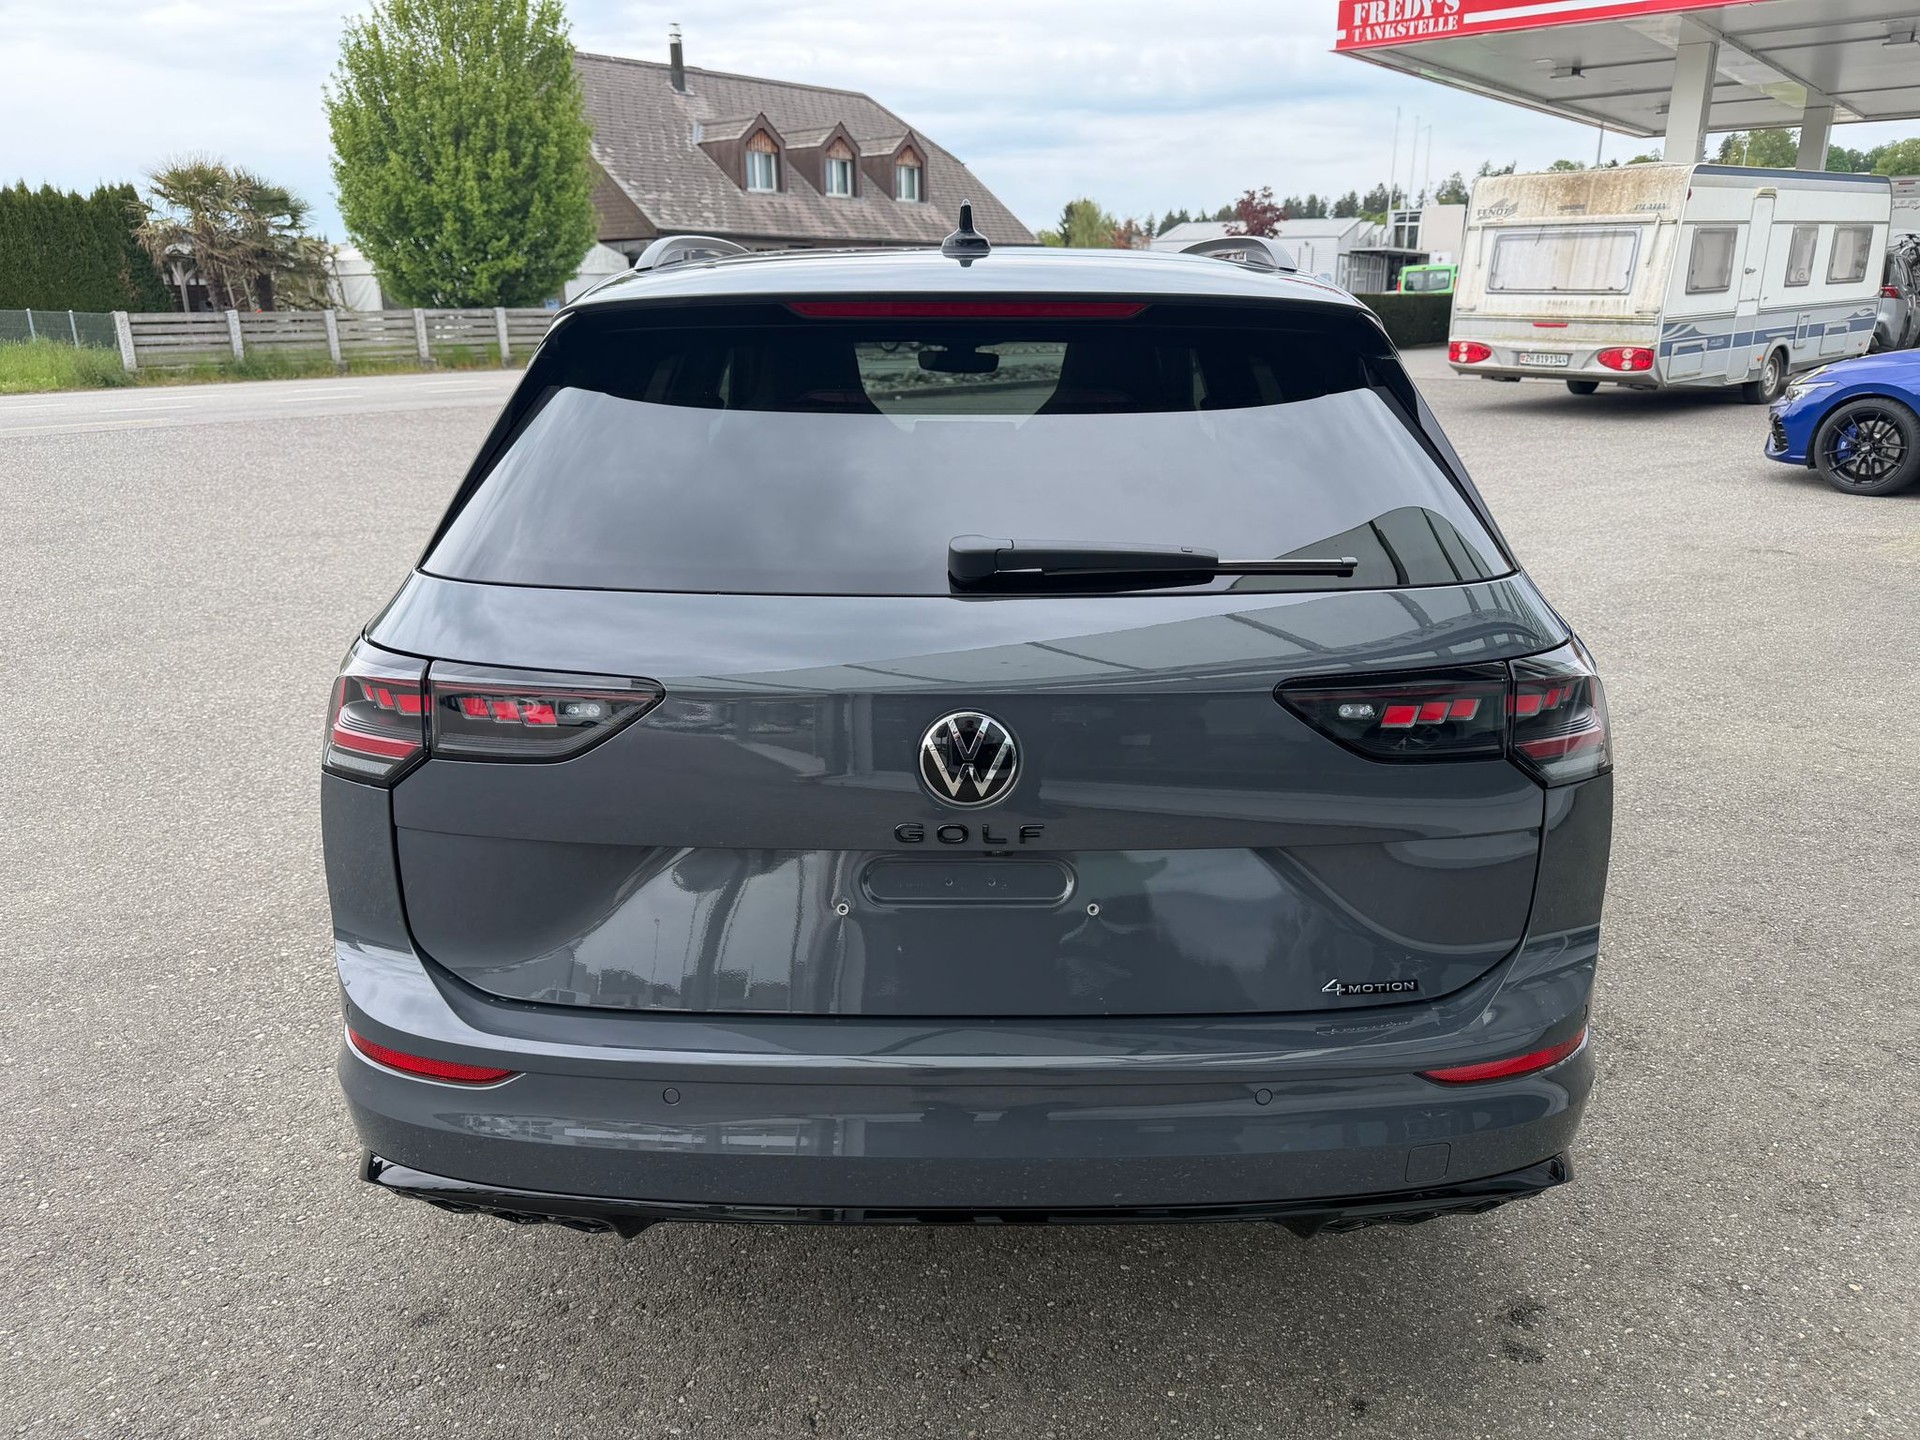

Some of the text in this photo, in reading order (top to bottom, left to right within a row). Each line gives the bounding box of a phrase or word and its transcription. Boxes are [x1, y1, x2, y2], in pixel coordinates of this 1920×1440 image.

[1352, 15, 1459, 42] TANKSTELLE
[894, 823, 1045, 844] GOLF
[1321, 979, 1415, 996] 4MOTION
